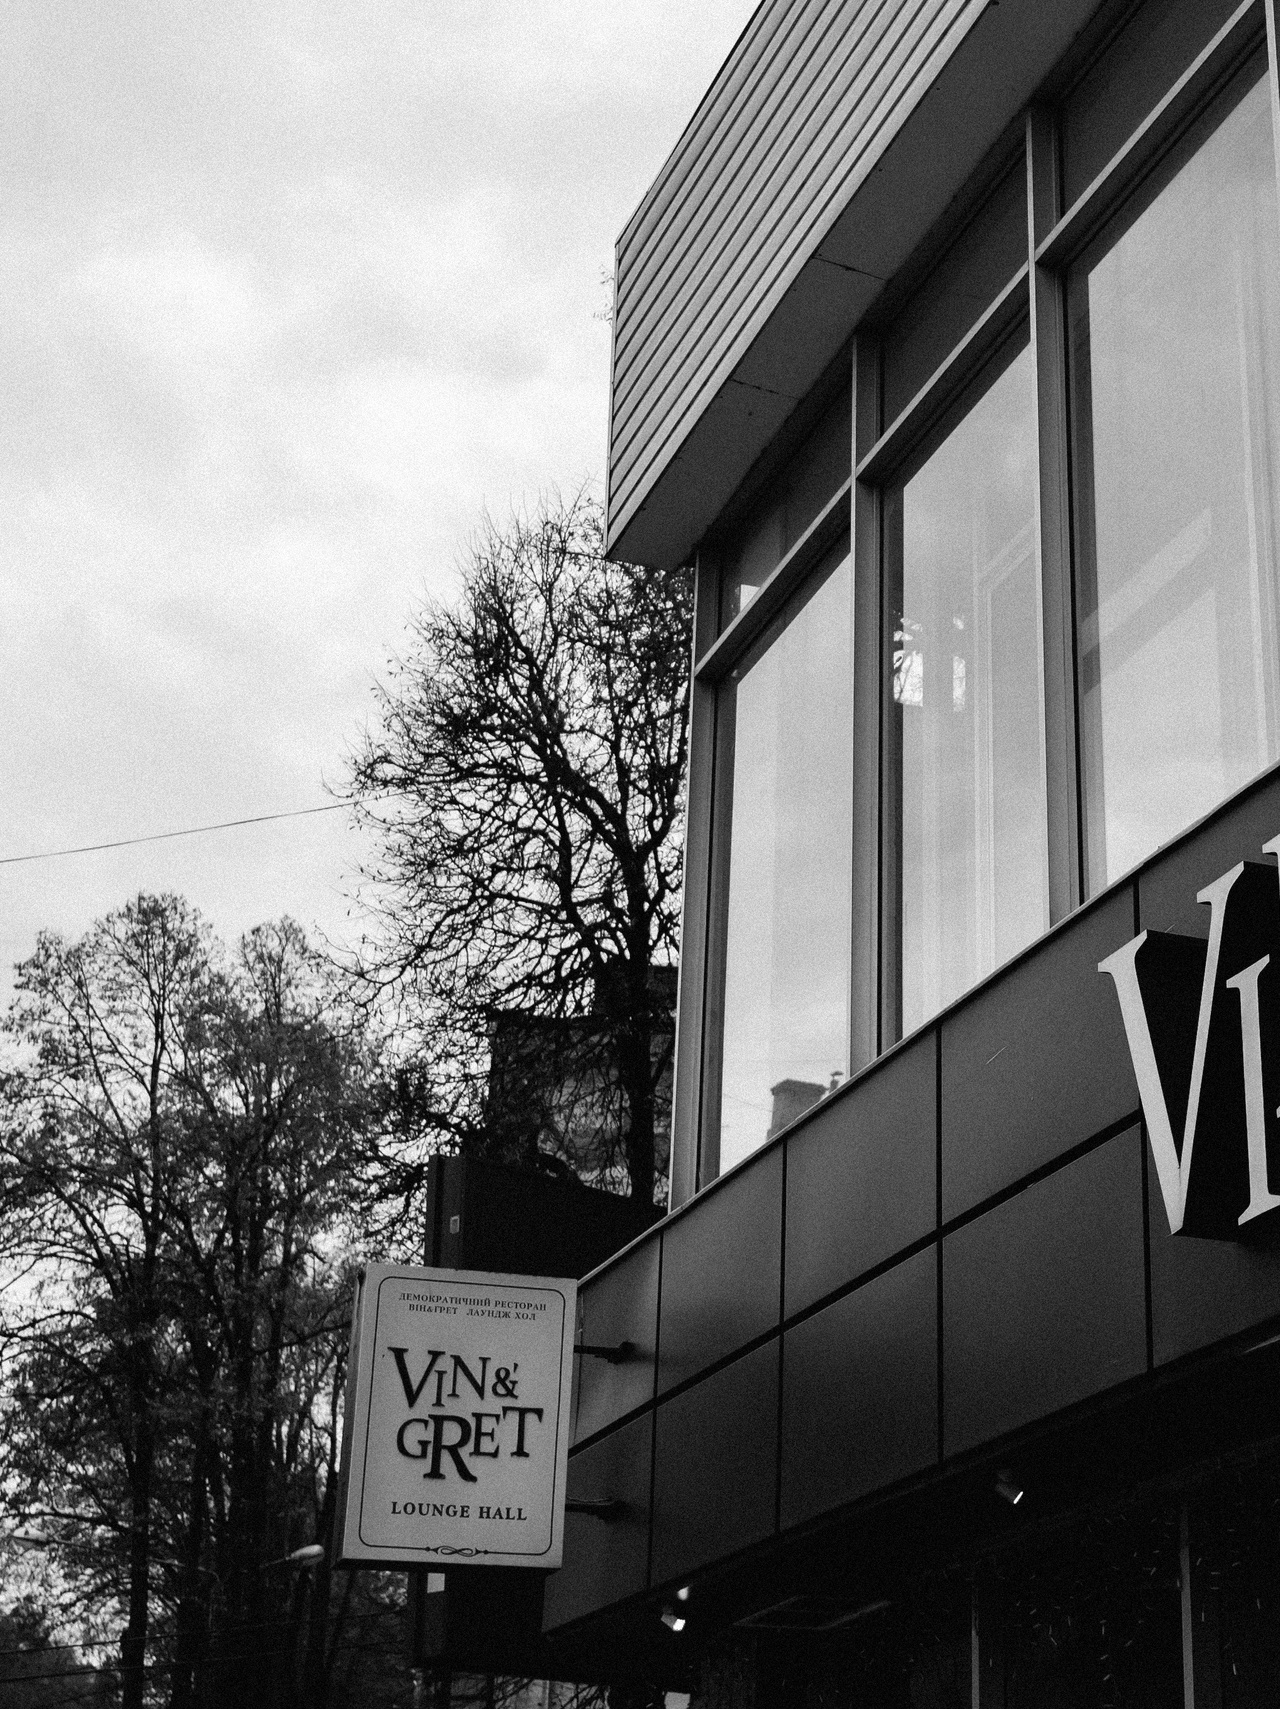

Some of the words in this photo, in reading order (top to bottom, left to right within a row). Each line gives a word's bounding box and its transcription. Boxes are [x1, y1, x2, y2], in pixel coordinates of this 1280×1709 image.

[398, 1292, 491, 1307] ДЕМОКРАТИЧНИЙ
[494, 1299, 547, 1312] РЕСТОРАН
[466, 1308, 512, 1319] ЛАУНДЖ
[514, 1311, 537, 1321] ХОЛ
[396, 1406, 544, 1483] GRET
[391, 1501, 471, 1519] LOUNGE
[478, 1506, 528, 1522] HALL
